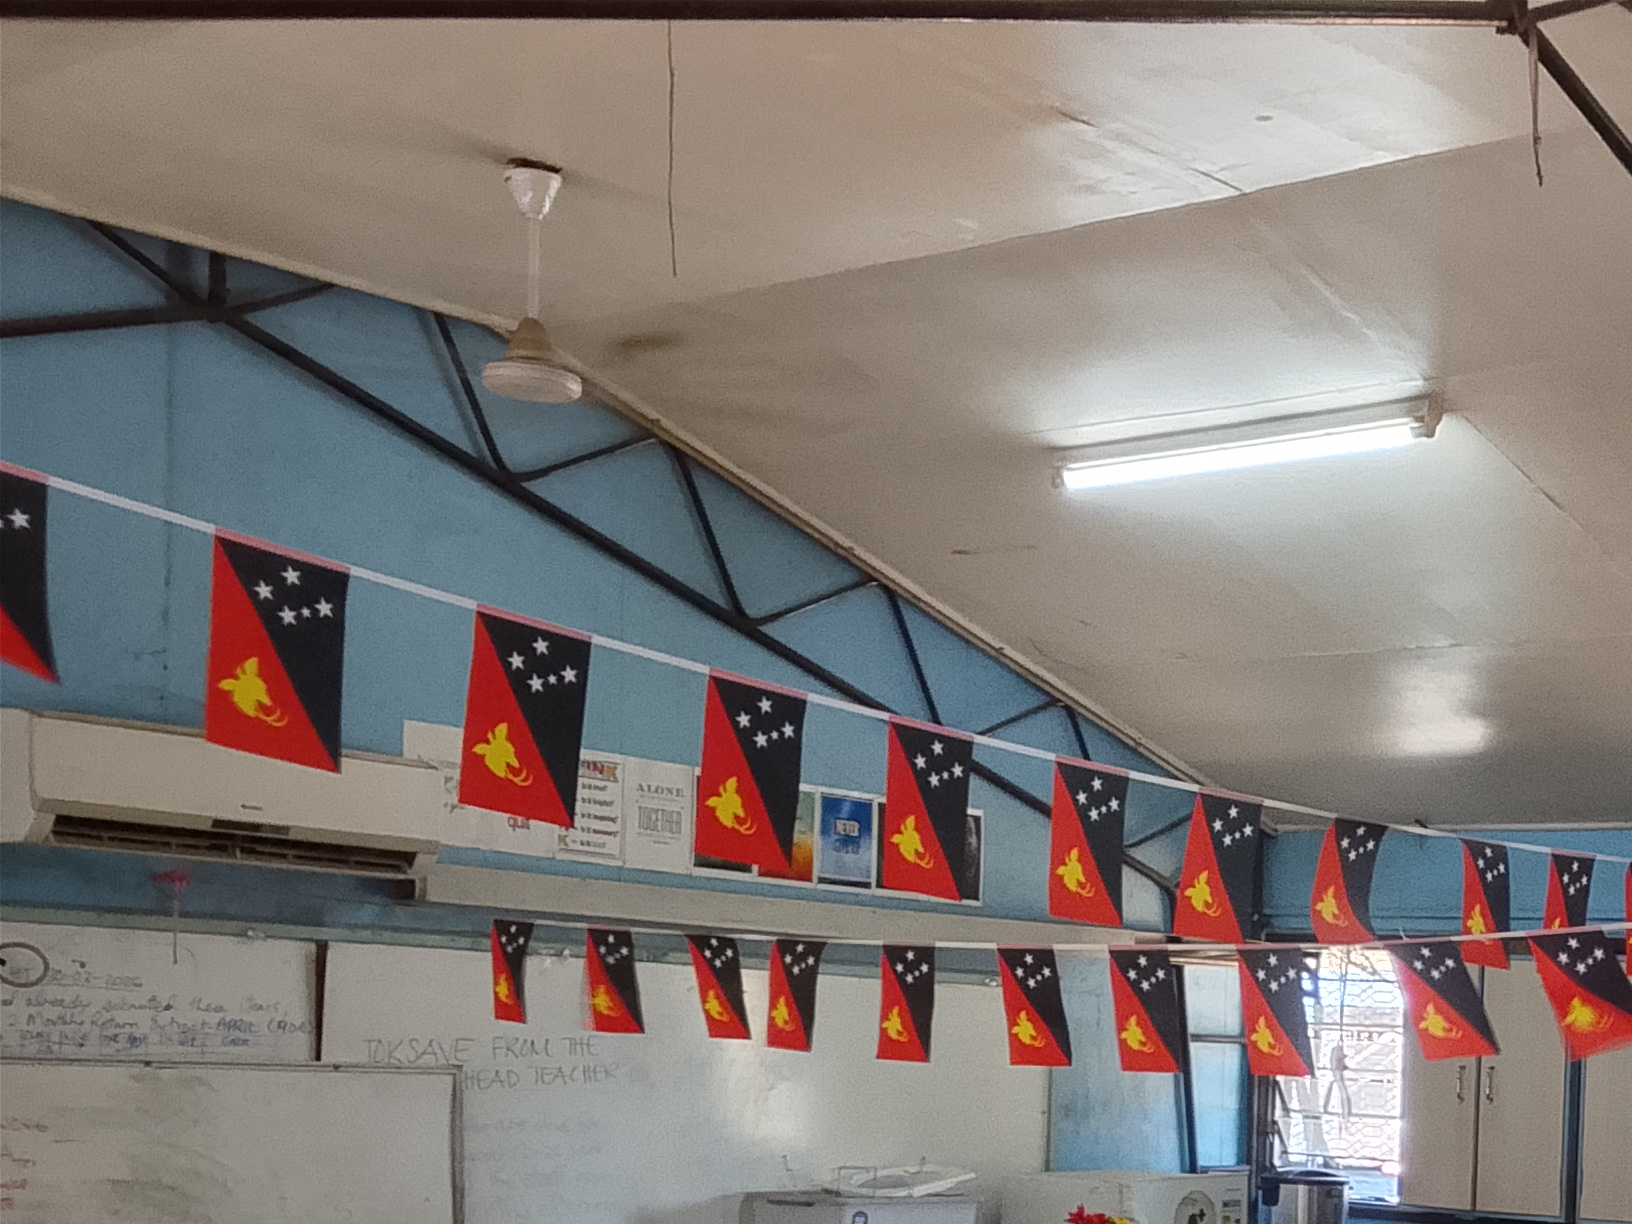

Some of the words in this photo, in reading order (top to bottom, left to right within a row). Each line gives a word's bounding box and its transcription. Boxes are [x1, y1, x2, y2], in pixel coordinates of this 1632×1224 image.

[635, 782, 685, 798] ALONE
[492, 1036, 549, 1061] FROM
[562, 1036, 600, 1057] THE
[463, 1069, 520, 1091] HEAD
[528, 1064, 620, 1085] TEACHER
